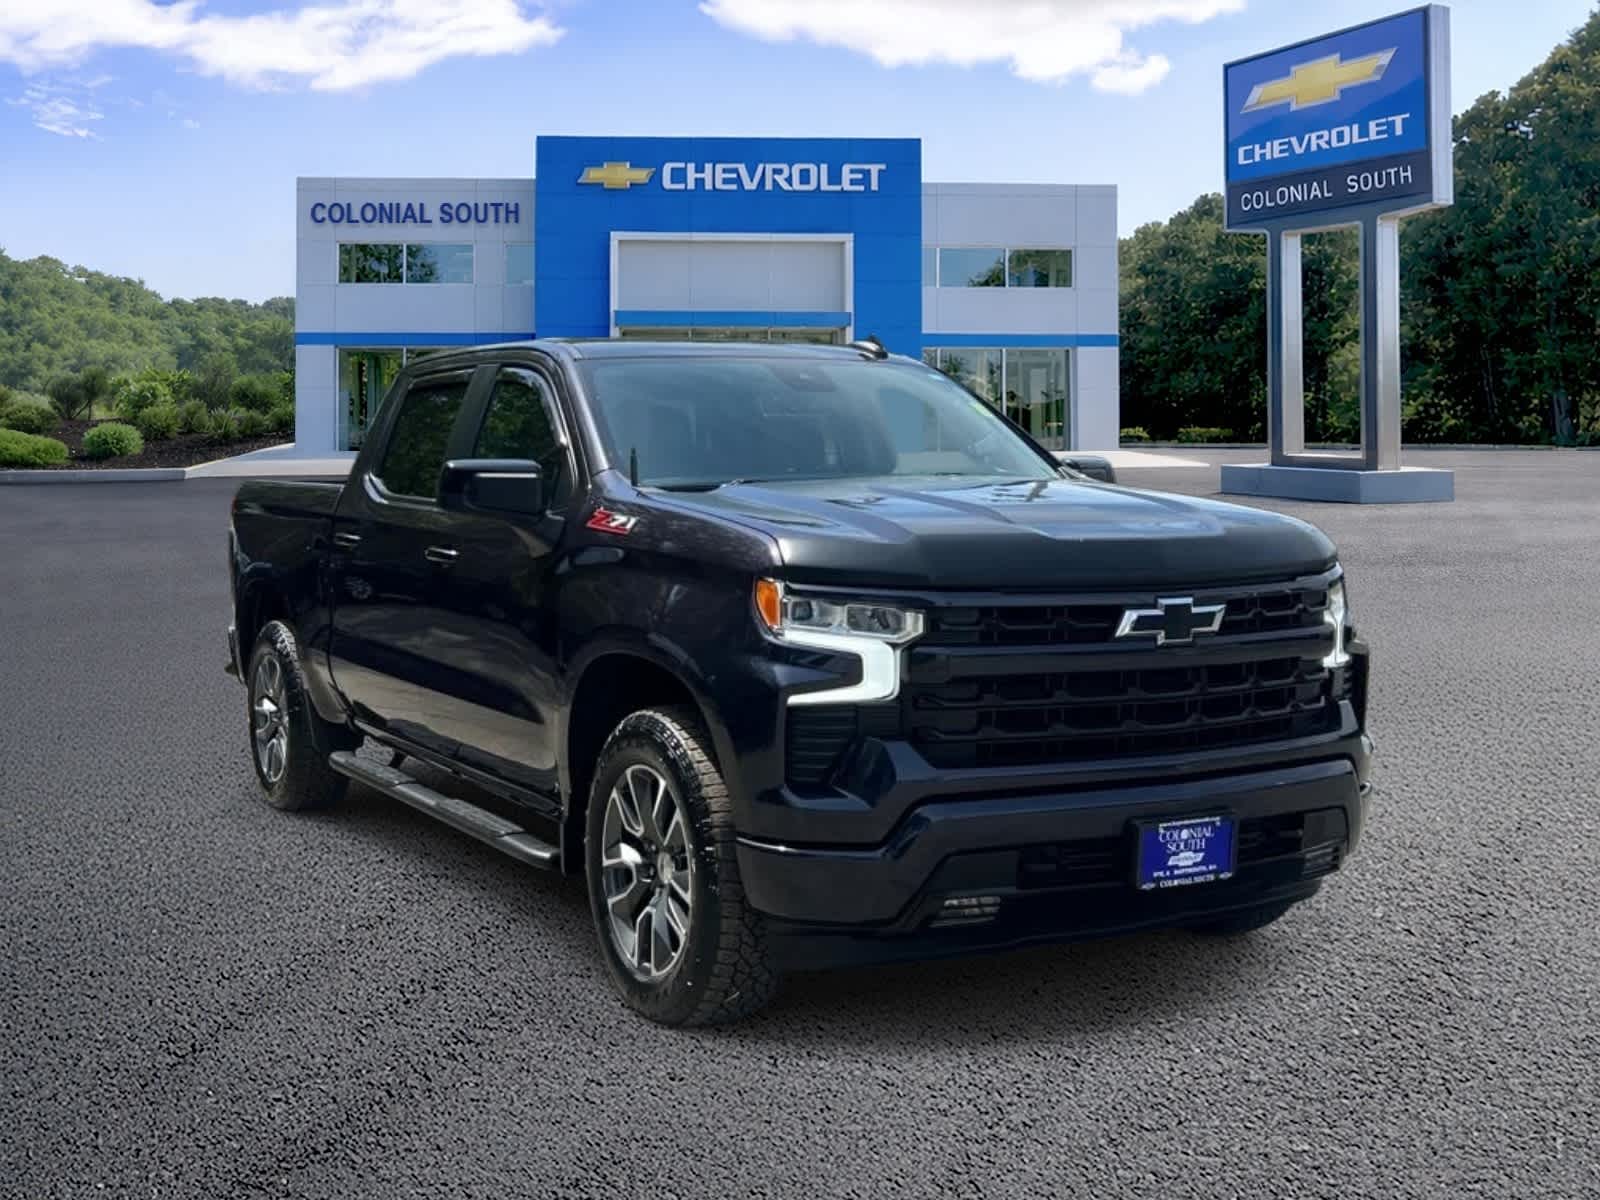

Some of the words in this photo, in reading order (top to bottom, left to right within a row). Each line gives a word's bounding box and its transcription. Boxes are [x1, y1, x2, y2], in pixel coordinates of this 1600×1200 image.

[1237, 113, 1410, 165] CHEVROLET
[662, 162, 887, 192] CHEVROLET
[1240, 180, 1333, 211] COLONIAL
[1346, 165, 1413, 193] SOUTH
[310, 202, 433, 224] COLONIAL
[439, 203, 520, 224] SOUTH
[586, 507, 639, 534] Z71
[1159, 825, 1214, 843] COLONIAL
[1166, 838, 1206, 854] SOUTH
